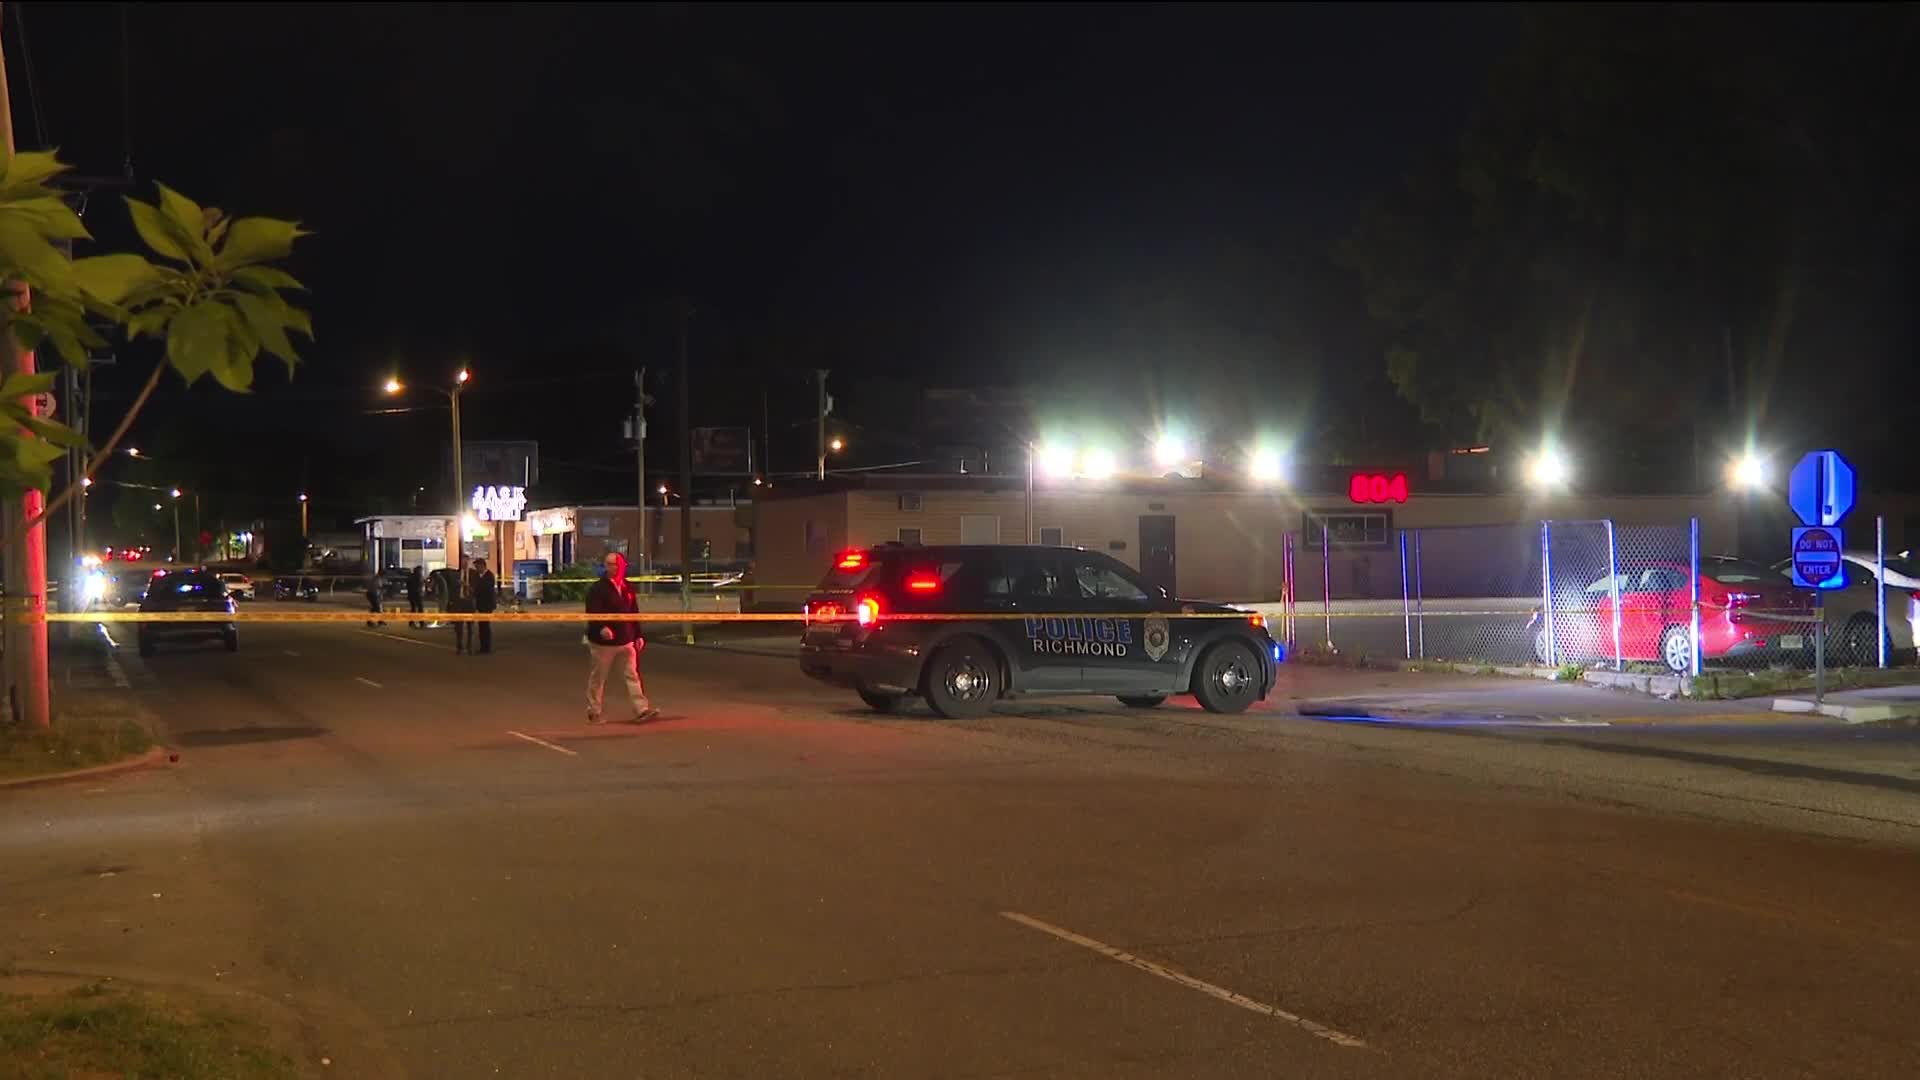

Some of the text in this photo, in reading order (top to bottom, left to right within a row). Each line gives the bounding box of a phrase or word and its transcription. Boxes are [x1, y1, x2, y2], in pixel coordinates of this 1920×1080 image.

[474, 486, 525, 499] JACK
[1350, 472, 1407, 503] 804
[1800, 540, 1834, 550] DO NOT
[1803, 565, 1831, 575] ENTER
[1024, 616, 1133, 644] POLICE
[1033, 639, 1127, 657] RICHMOND
